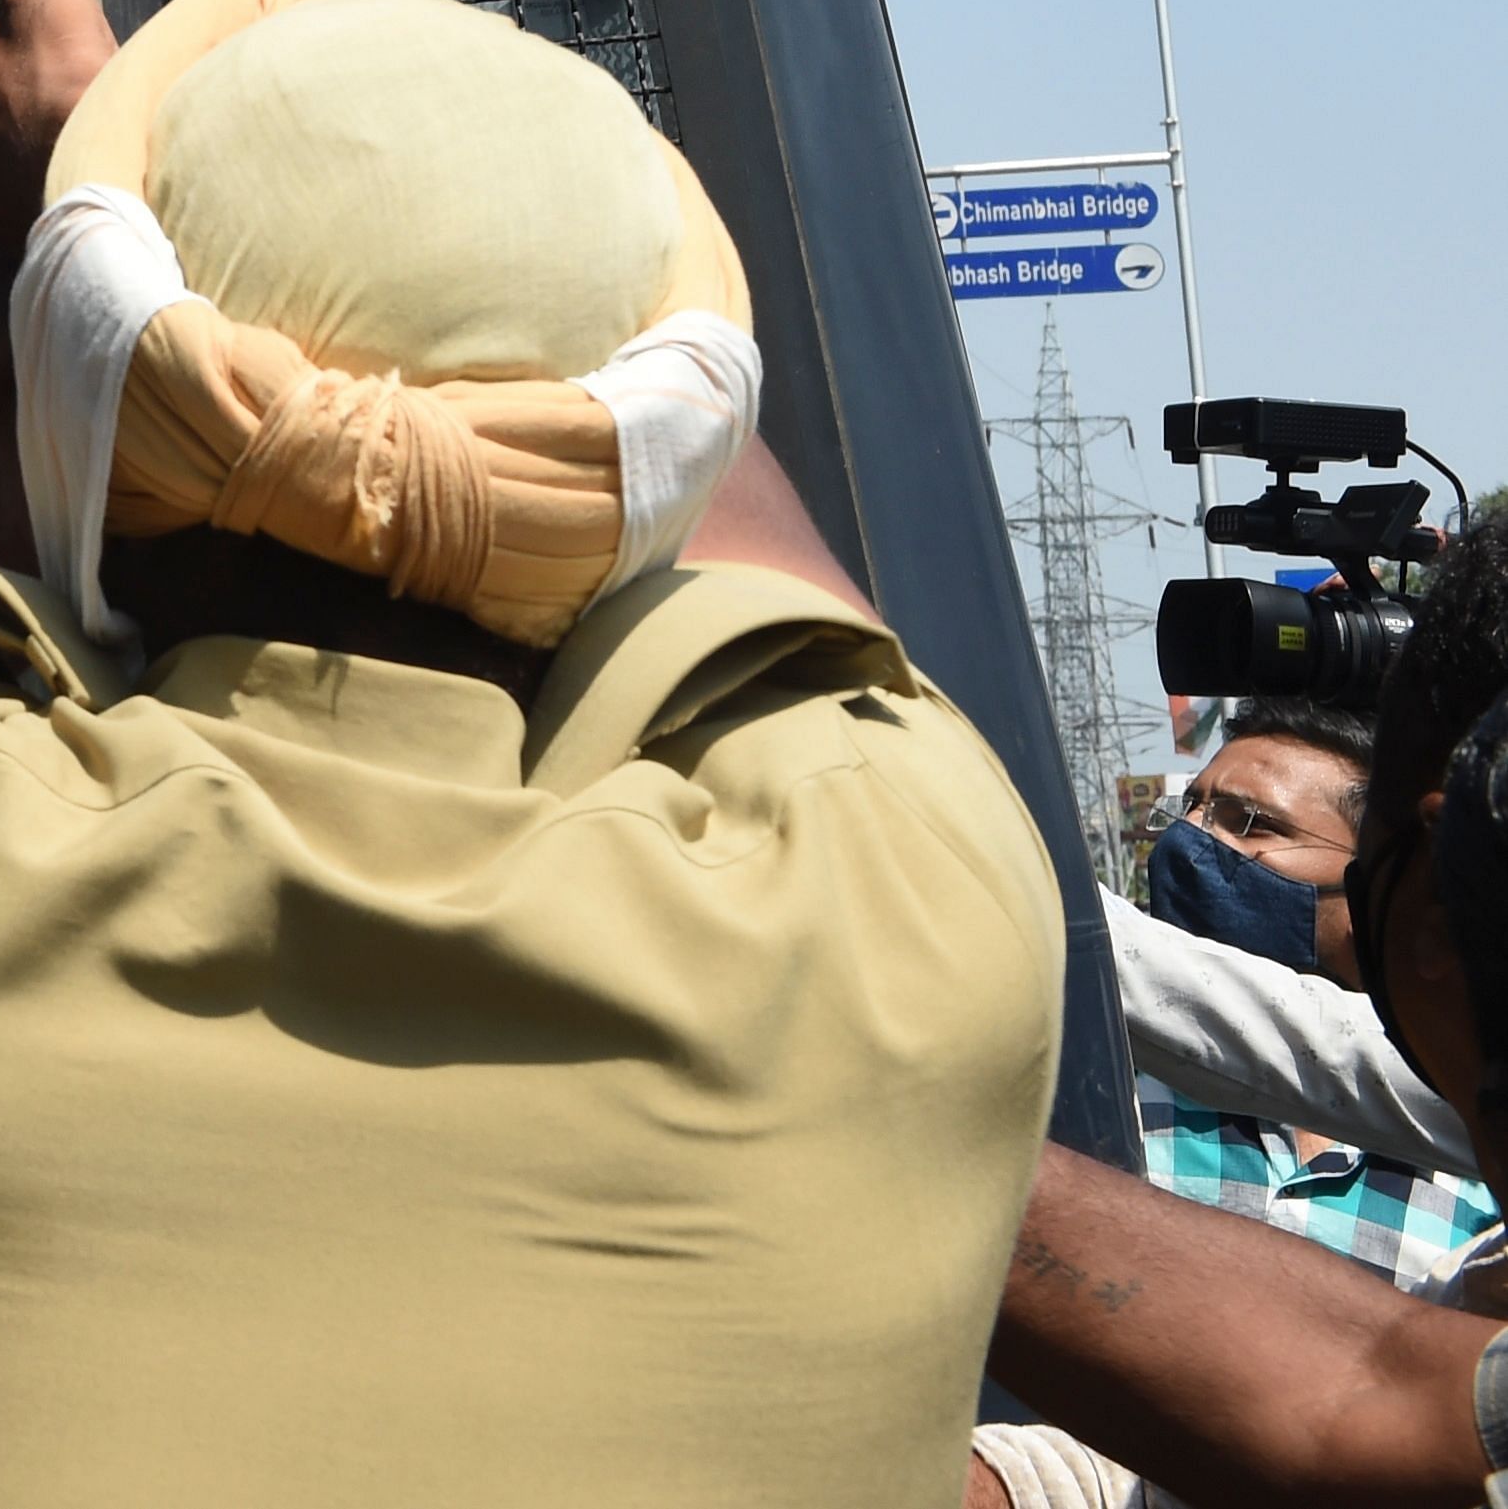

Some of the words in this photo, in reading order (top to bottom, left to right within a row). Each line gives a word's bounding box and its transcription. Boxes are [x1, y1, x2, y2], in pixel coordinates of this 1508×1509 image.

[959, 196, 1075, 224] Chimanbhai
[1083, 193, 1150, 218] Bridge
[1017, 260, 1084, 283] Bridge
